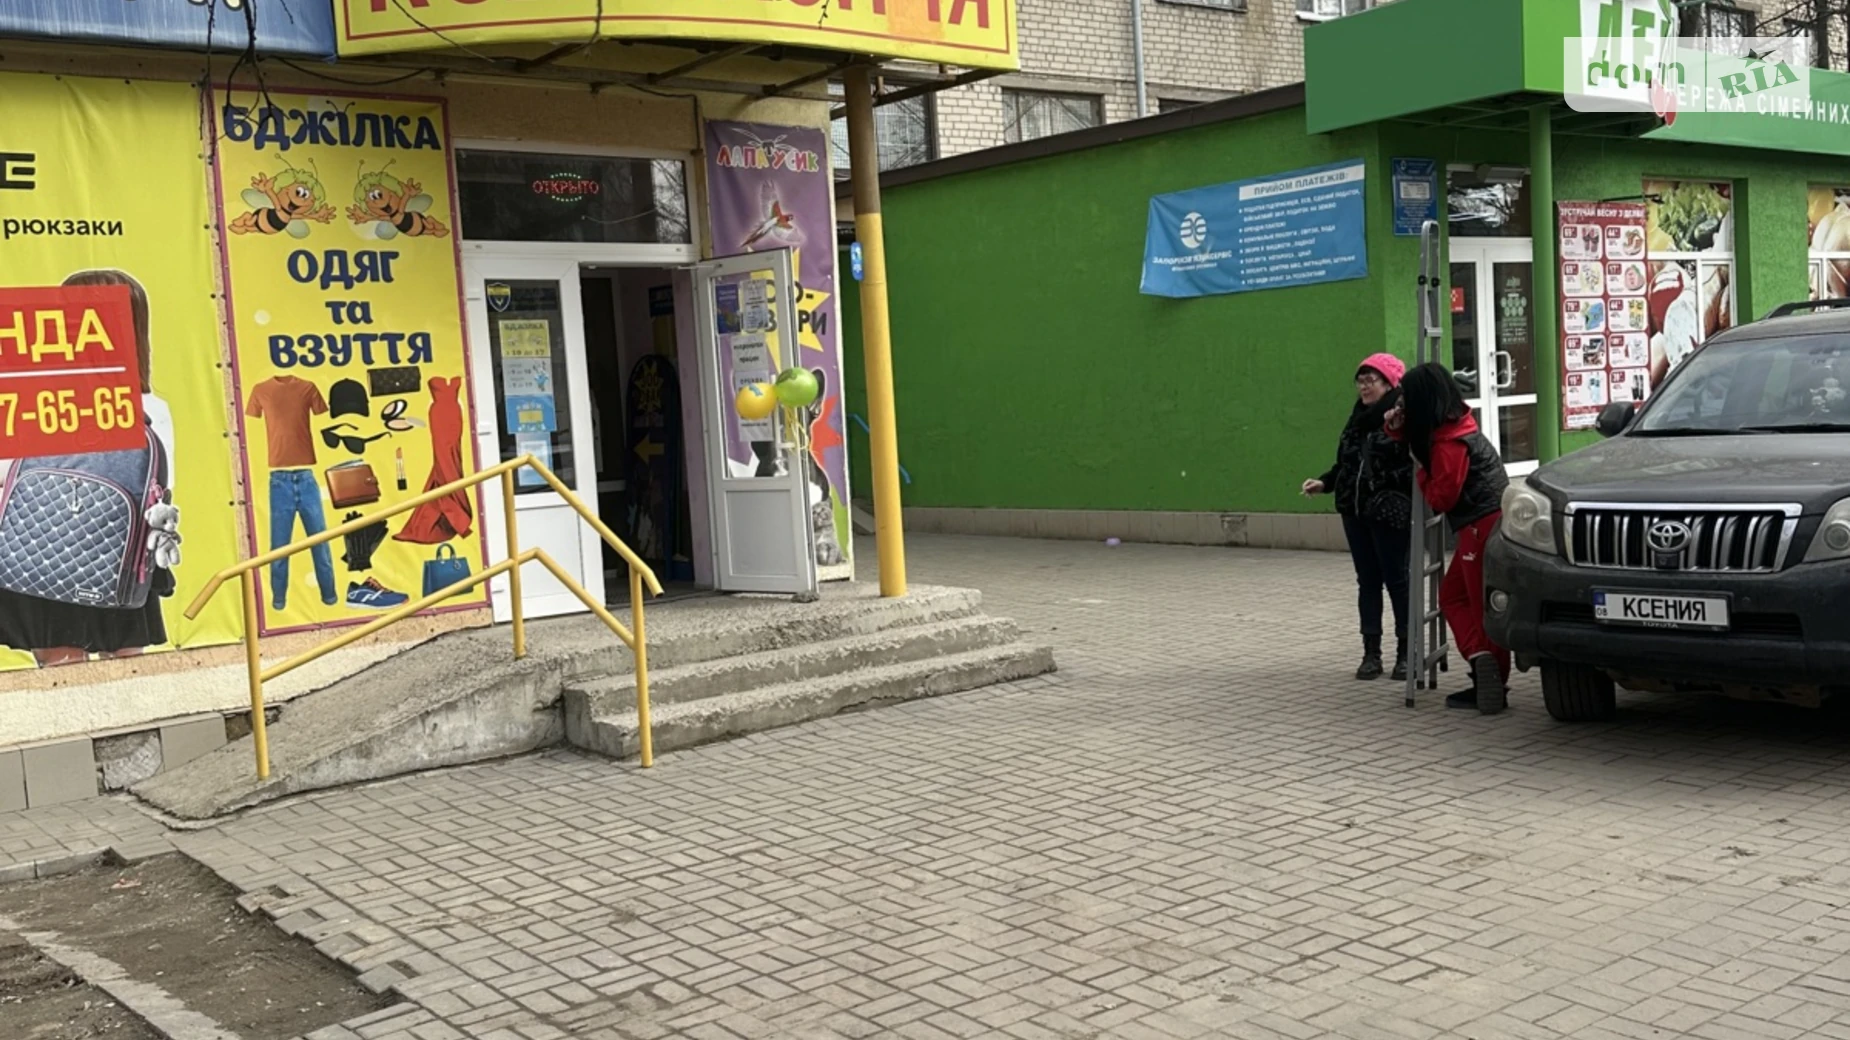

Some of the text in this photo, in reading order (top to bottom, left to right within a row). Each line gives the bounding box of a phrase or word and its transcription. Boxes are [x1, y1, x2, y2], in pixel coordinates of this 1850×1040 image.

[1756, 93, 1850, 125] СІМЕЙНИХ
[222, 105, 442, 151] БДЖІЛКА
[532, 180, 599, 194] ОТКРЫТО
[1254, 181, 1293, 196] ПРИЙОМ
[3, 218, 124, 240] рюкзаки
[287, 250, 399, 290] ОДЯГ
[325, 301, 373, 325] та
[268, 332, 433, 368] ВЗУТТЯ
[1622, 597, 1706, 621] КСЕНИЯ
